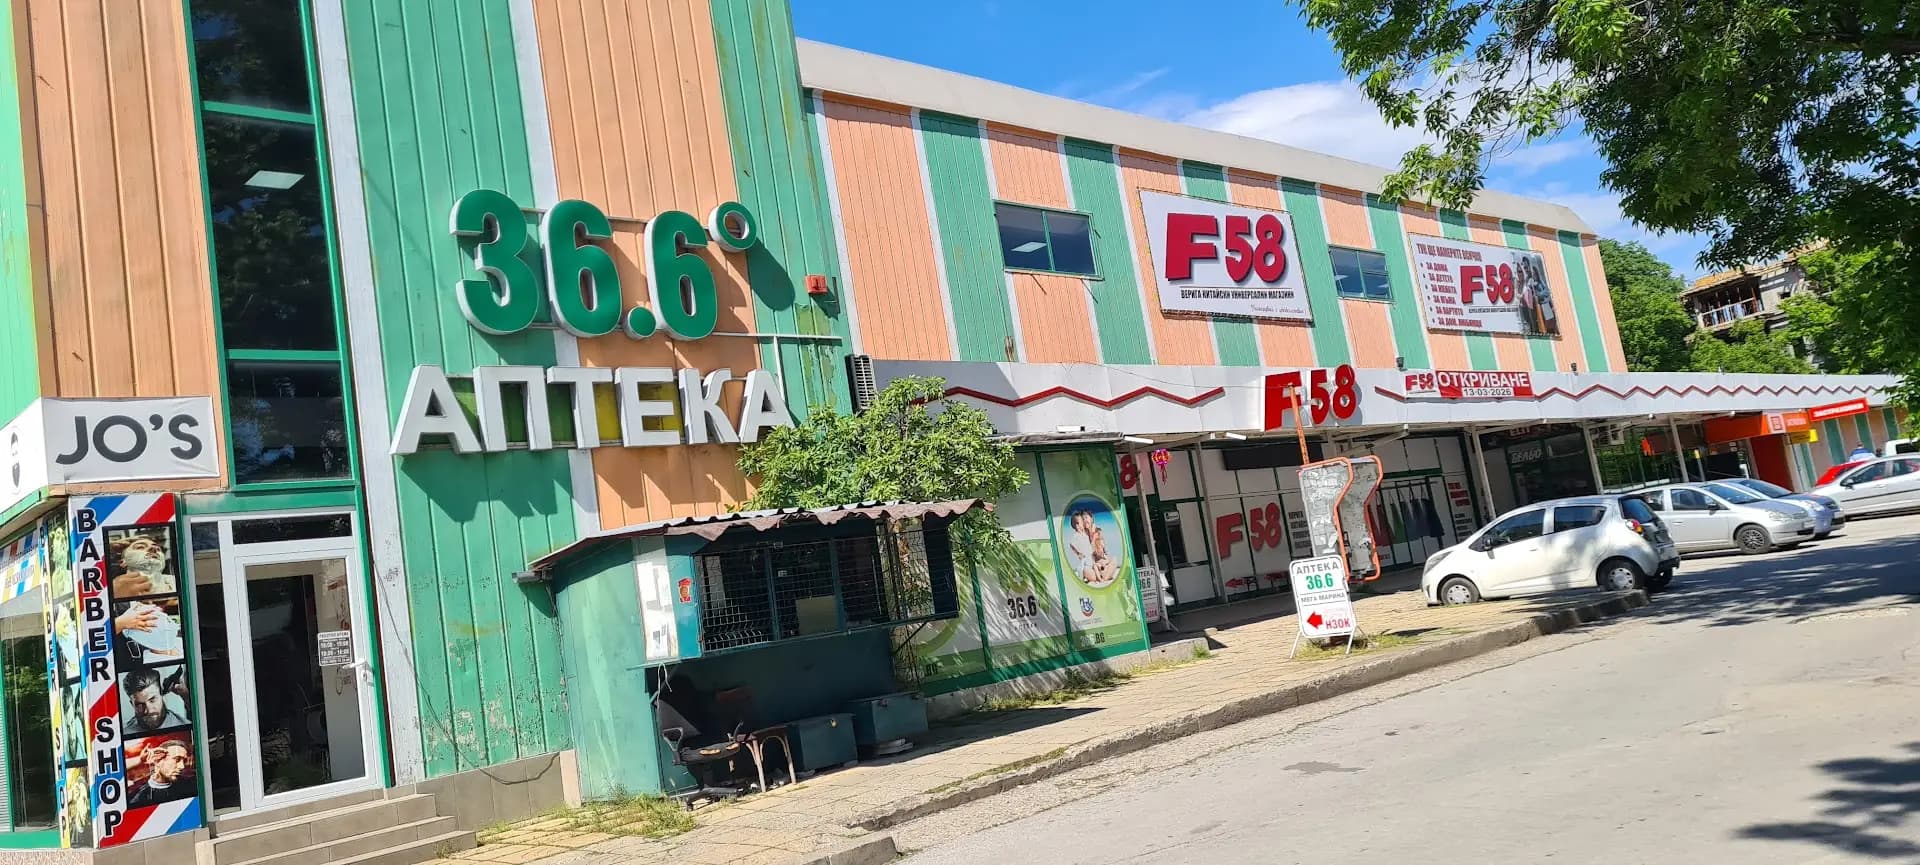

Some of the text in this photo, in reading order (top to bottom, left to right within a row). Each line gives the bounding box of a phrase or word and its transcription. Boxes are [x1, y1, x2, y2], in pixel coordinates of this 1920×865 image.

[1165, 213, 1286, 283] F58
[1181, 288, 1294, 300] ВЕРИГА КИТАЙСКИ УНИВЕРСАЛНИ МАГАЗИНИ
[1460, 263, 1515, 304] F58
[1264, 364, 1357, 431] F58
[1405, 373, 1434, 390] F58
[1437, 371, 1530, 387] ОТКРИВАНЕ
[390, 364, 794, 454] АПТЕКА
[56, 413, 203, 465] JO'S
[1216, 502, 1282, 560] F58
[1296, 561, 1339, 575] АПТЕКА
[1306, 572, 1334, 590] 36.6
[77, 509, 114, 682] BARBER
[1007, 595, 1037, 619] 36.6
[1325, 617, 1351, 630] НЗОК
[96, 717, 125, 837] SHOP
